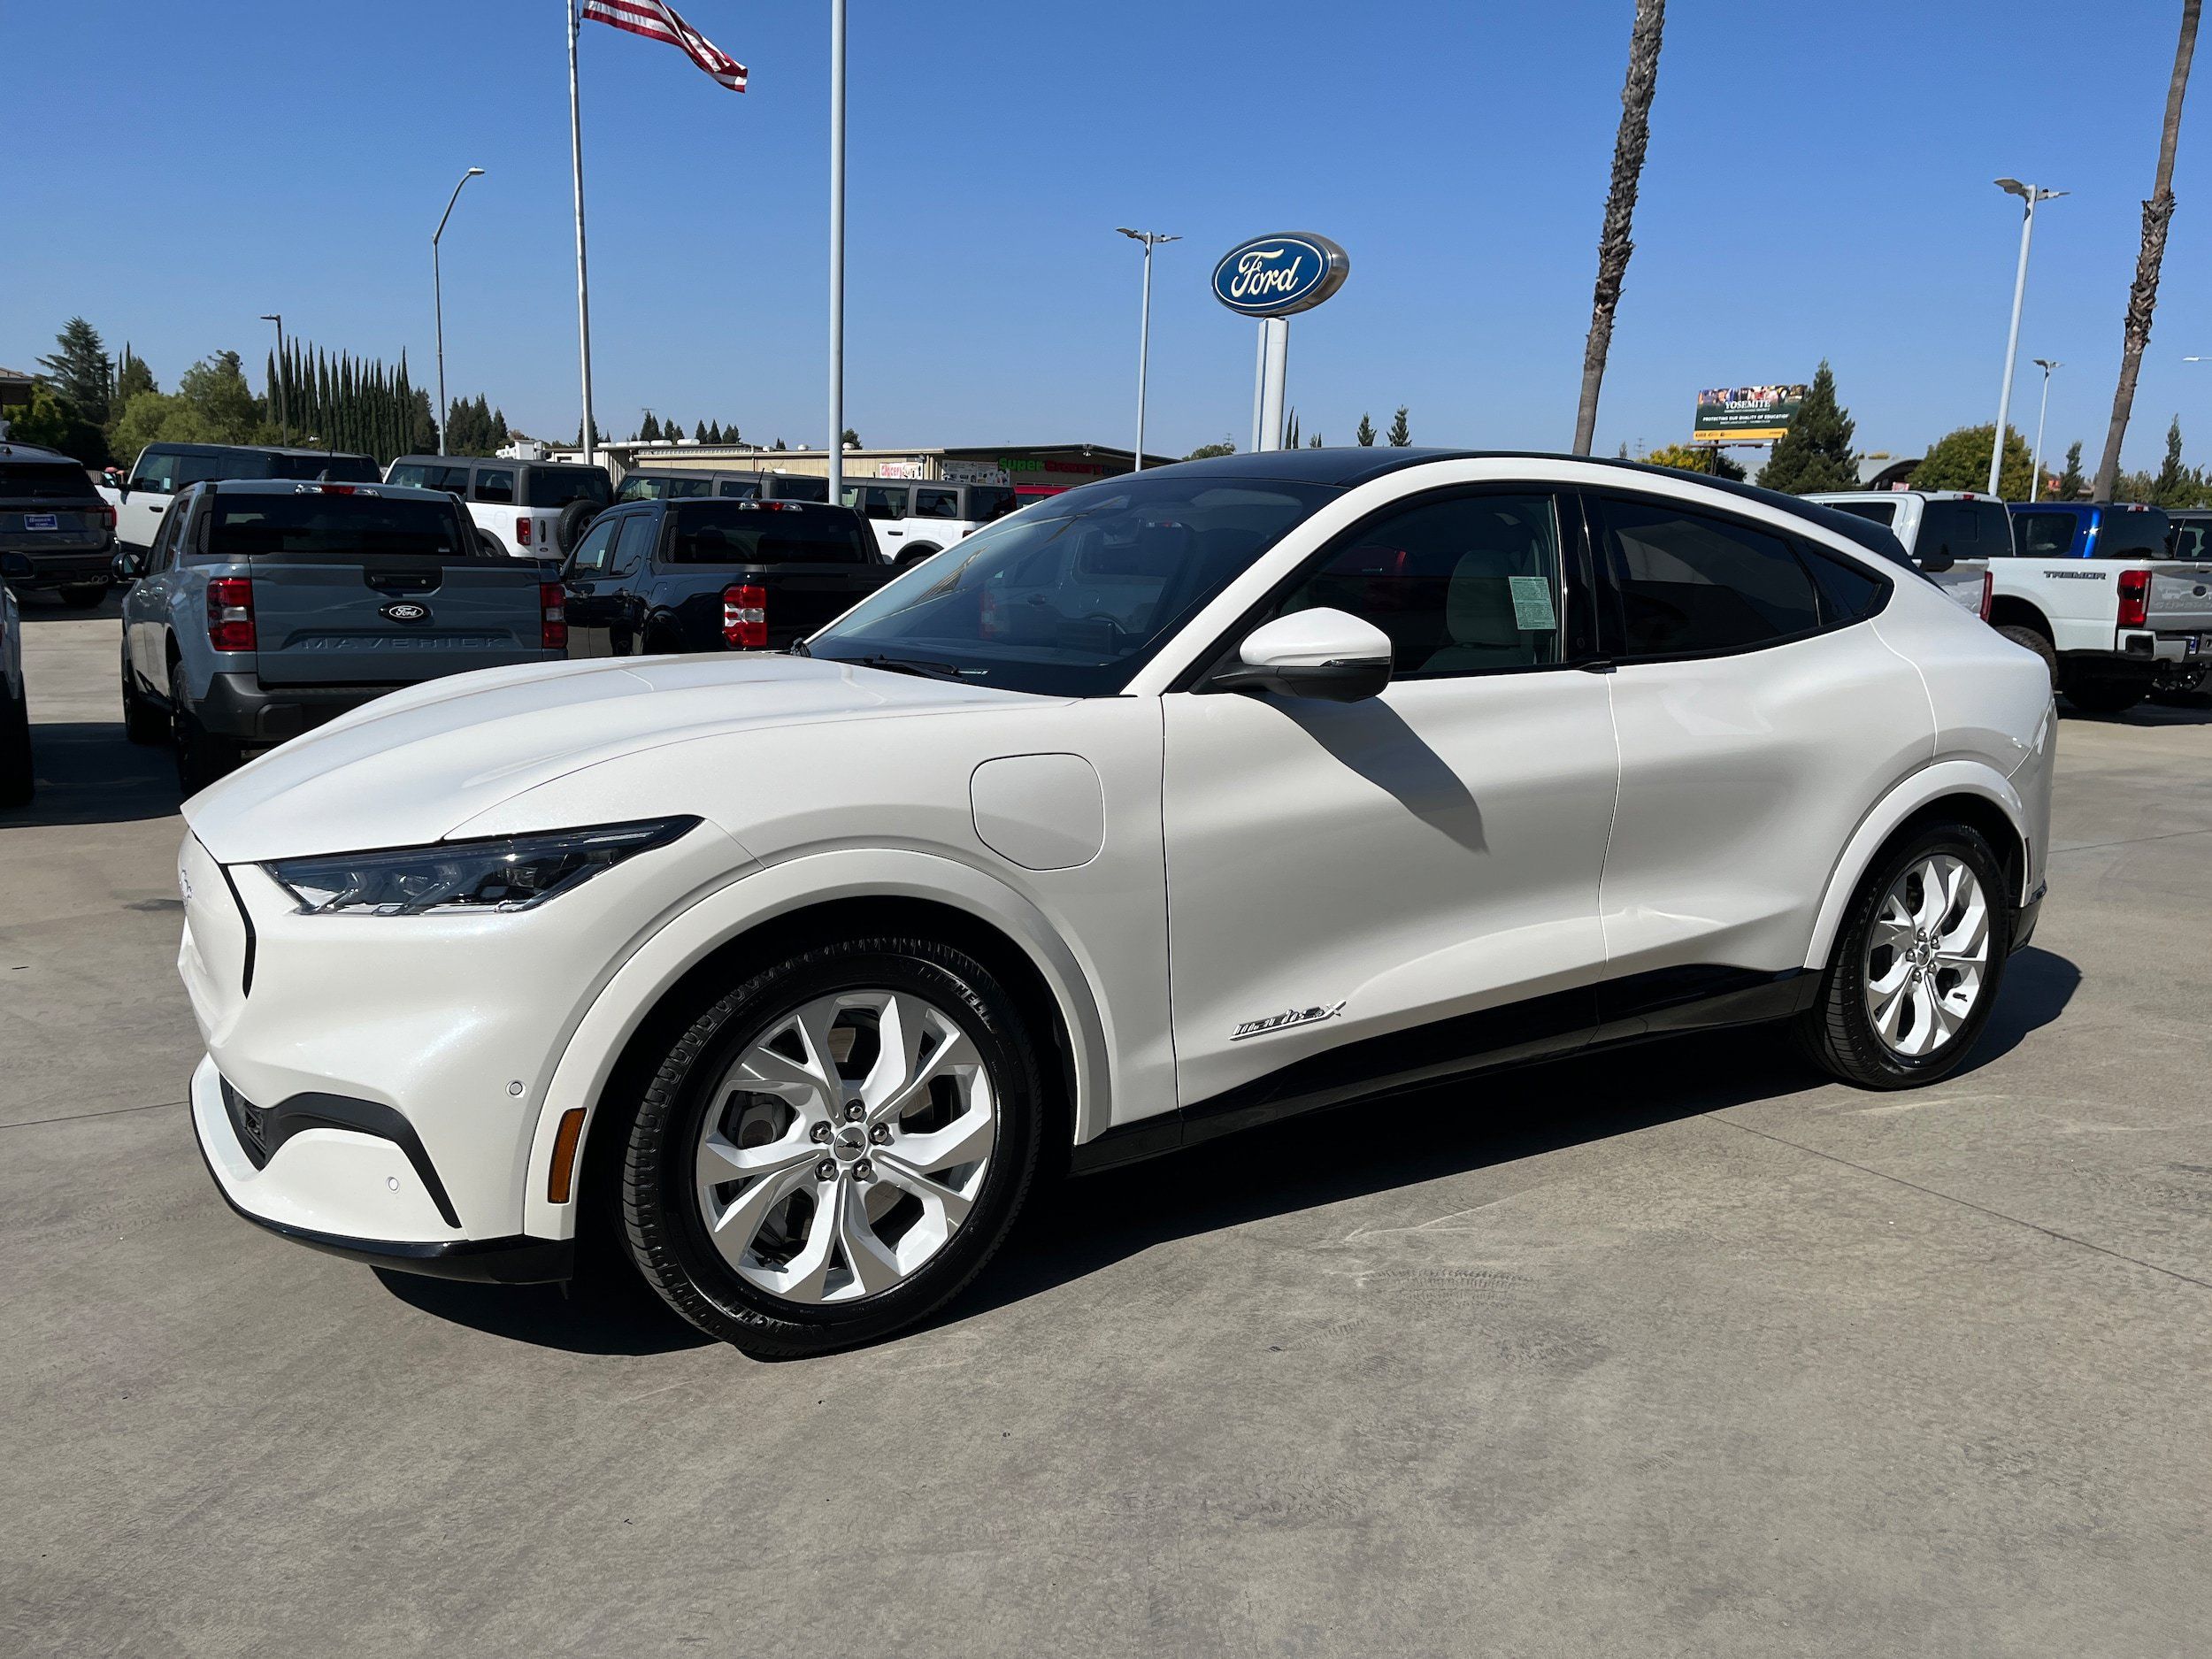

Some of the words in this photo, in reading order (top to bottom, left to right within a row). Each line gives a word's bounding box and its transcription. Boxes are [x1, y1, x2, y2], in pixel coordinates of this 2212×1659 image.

[1231, 249, 1302, 297] Ford
[1724, 400, 1771, 410] YOSEMITE
[997, 457, 1043, 472] Super
[2044, 571, 2106, 580] TREMOR
[396, 606, 417, 617] Ford
[302, 637, 506, 651] MAVERICK
